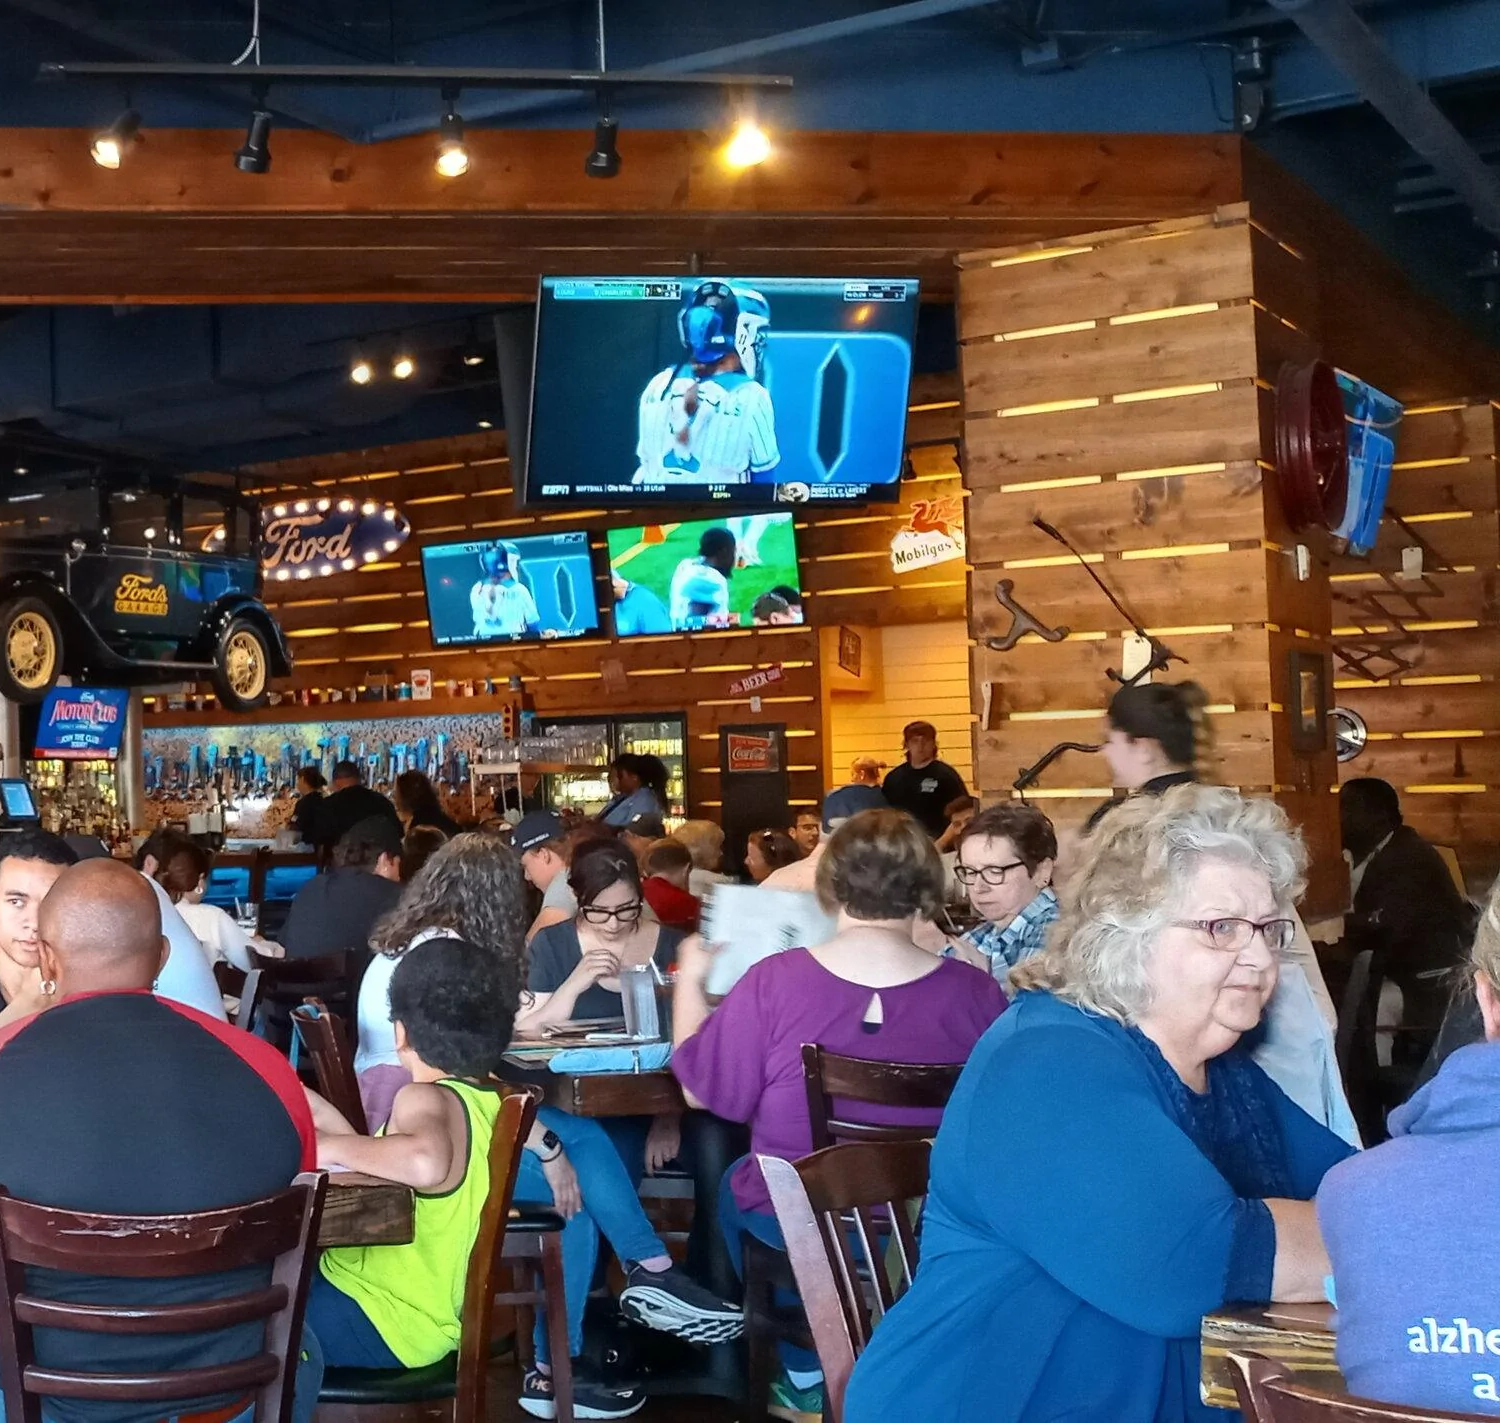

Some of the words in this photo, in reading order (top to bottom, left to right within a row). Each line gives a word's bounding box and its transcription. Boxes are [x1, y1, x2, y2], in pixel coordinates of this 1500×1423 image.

[262, 513, 354, 569] Ford
[895, 542, 952, 565] Mobilgas
[741, 671, 769, 692] BEER
